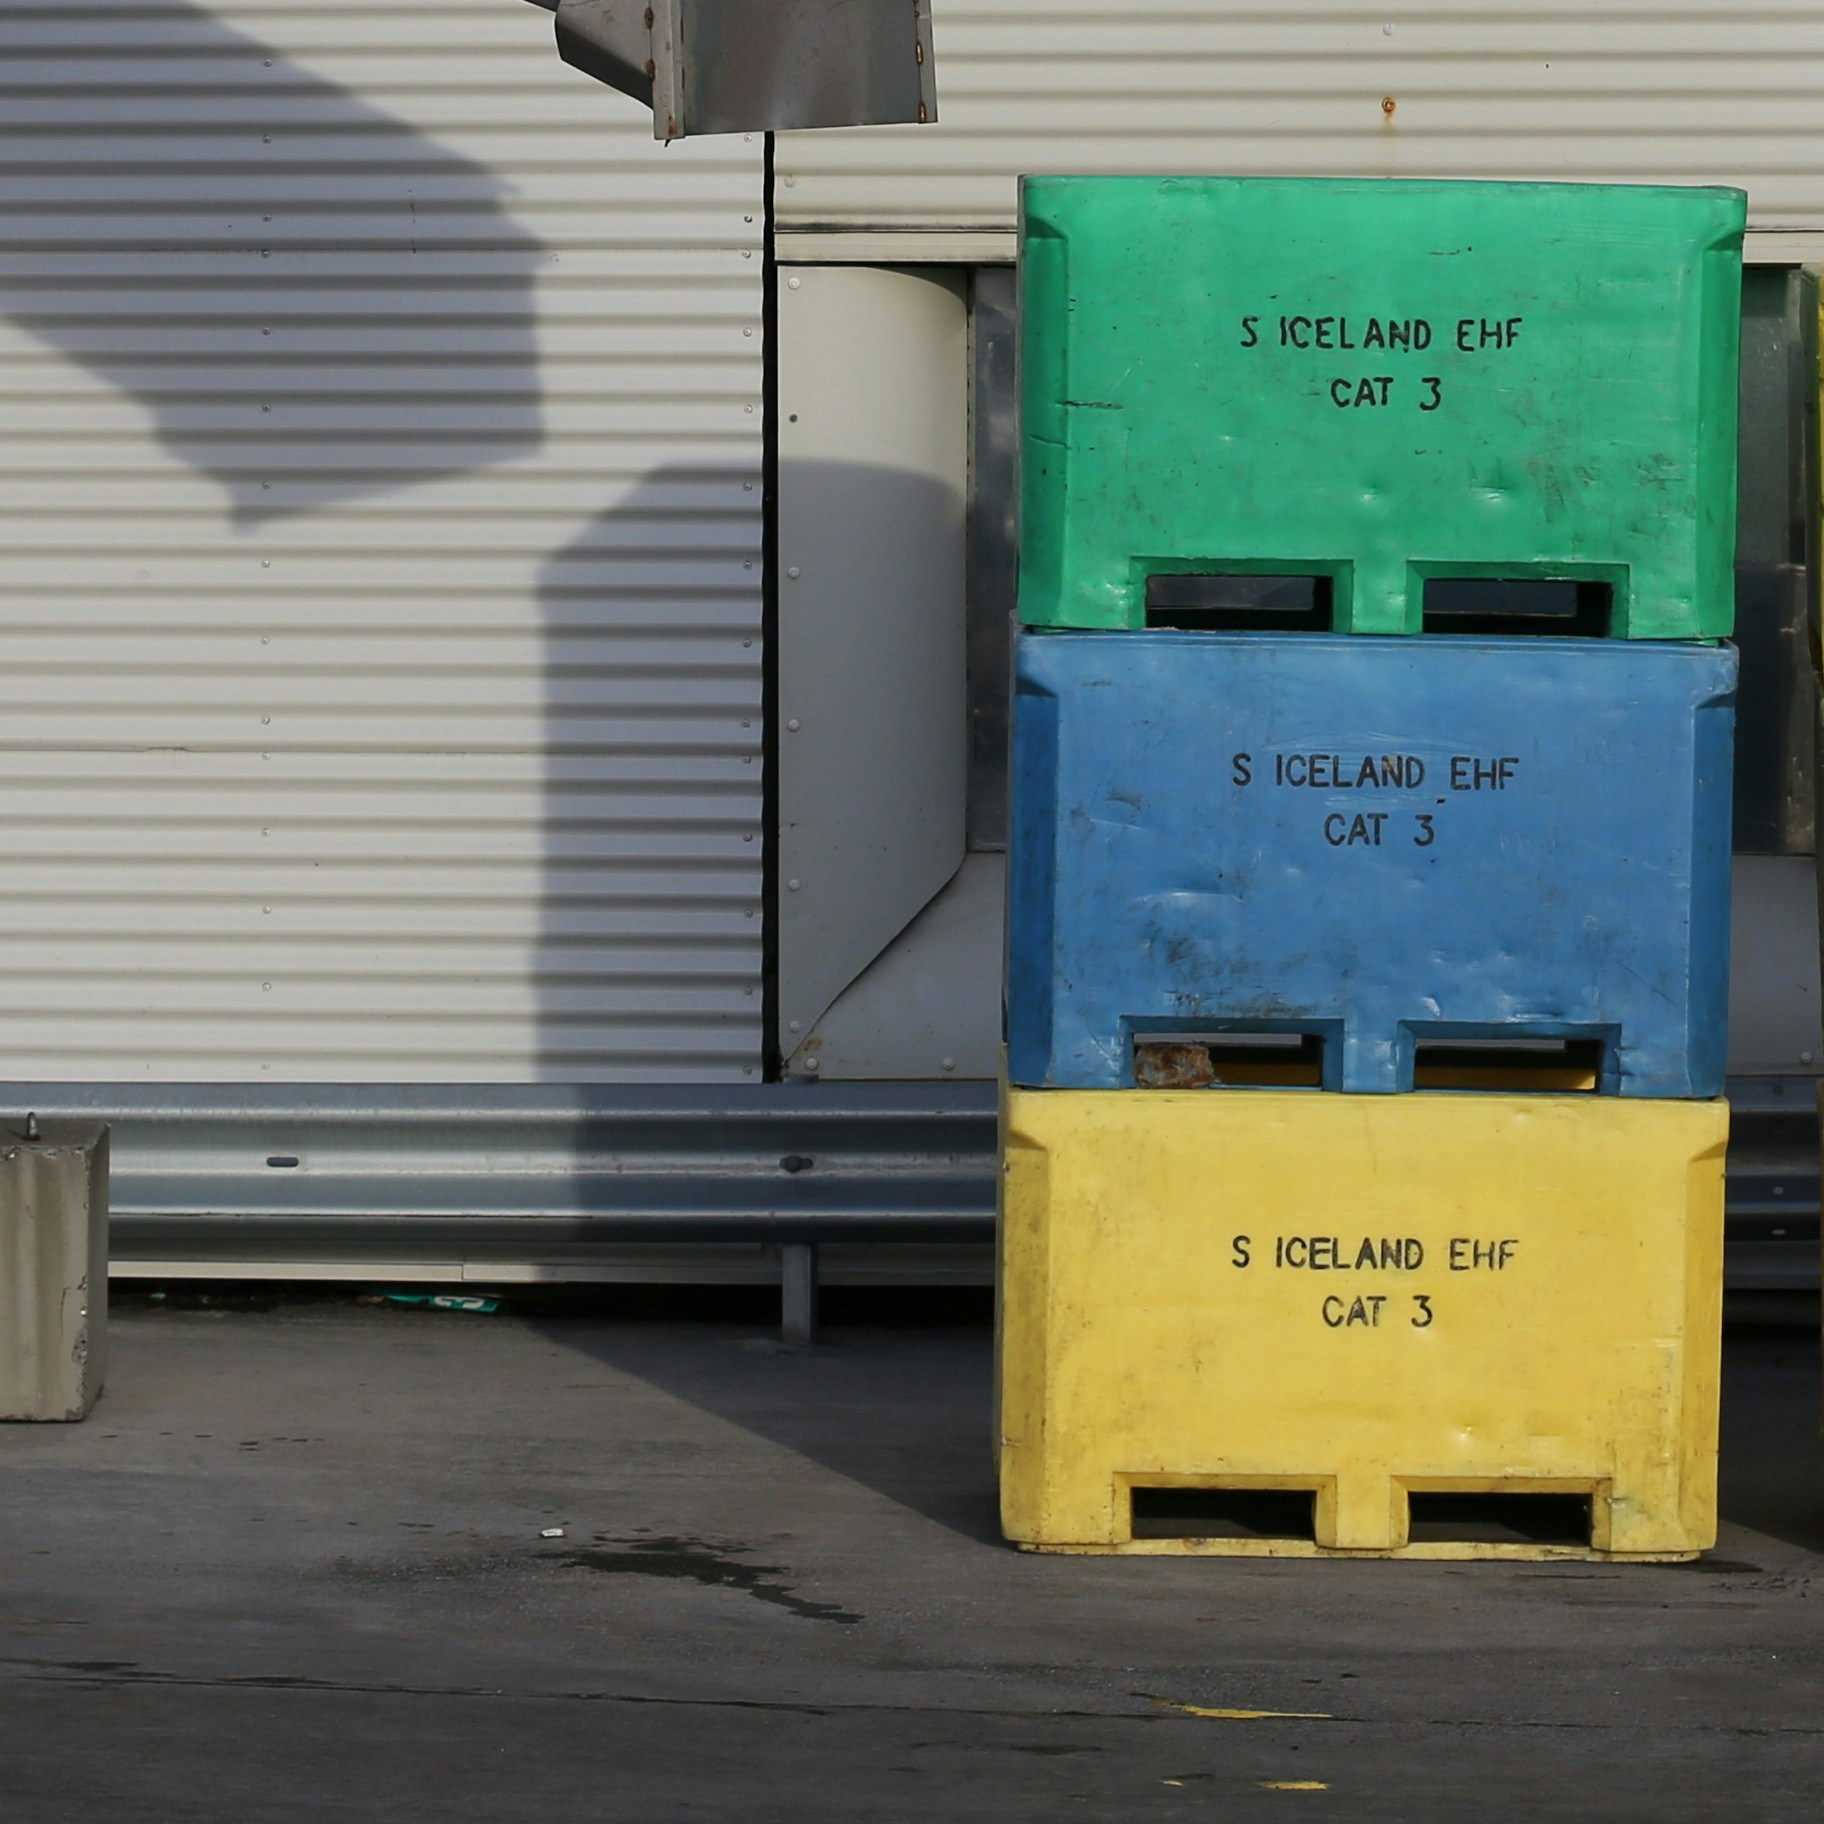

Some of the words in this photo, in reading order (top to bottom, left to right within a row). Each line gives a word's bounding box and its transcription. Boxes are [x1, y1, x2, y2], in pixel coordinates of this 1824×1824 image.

[1240, 316, 1258, 348] S
[1279, 316, 1432, 353] ICELAND
[1457, 317, 1523, 351] EHF
[1330, 377, 1394, 409] CAT
[1419, 377, 1442, 411] 3
[1232, 754, 1251, 788] S
[1276, 754, 1425, 789] ICELAND
[1450, 756, 1520, 791] EHF
[1324, 813, 1387, 847] CAT
[1414, 814, 1435, 847] 3
[1232, 1234, 1250, 1268] S
[1276, 1236, 1424, 1271] ICELAND
[1449, 1237, 1519, 1272] EHF
[1322, 1295, 1386, 1327] CAT
[1411, 1295, 1434, 1329] 3
